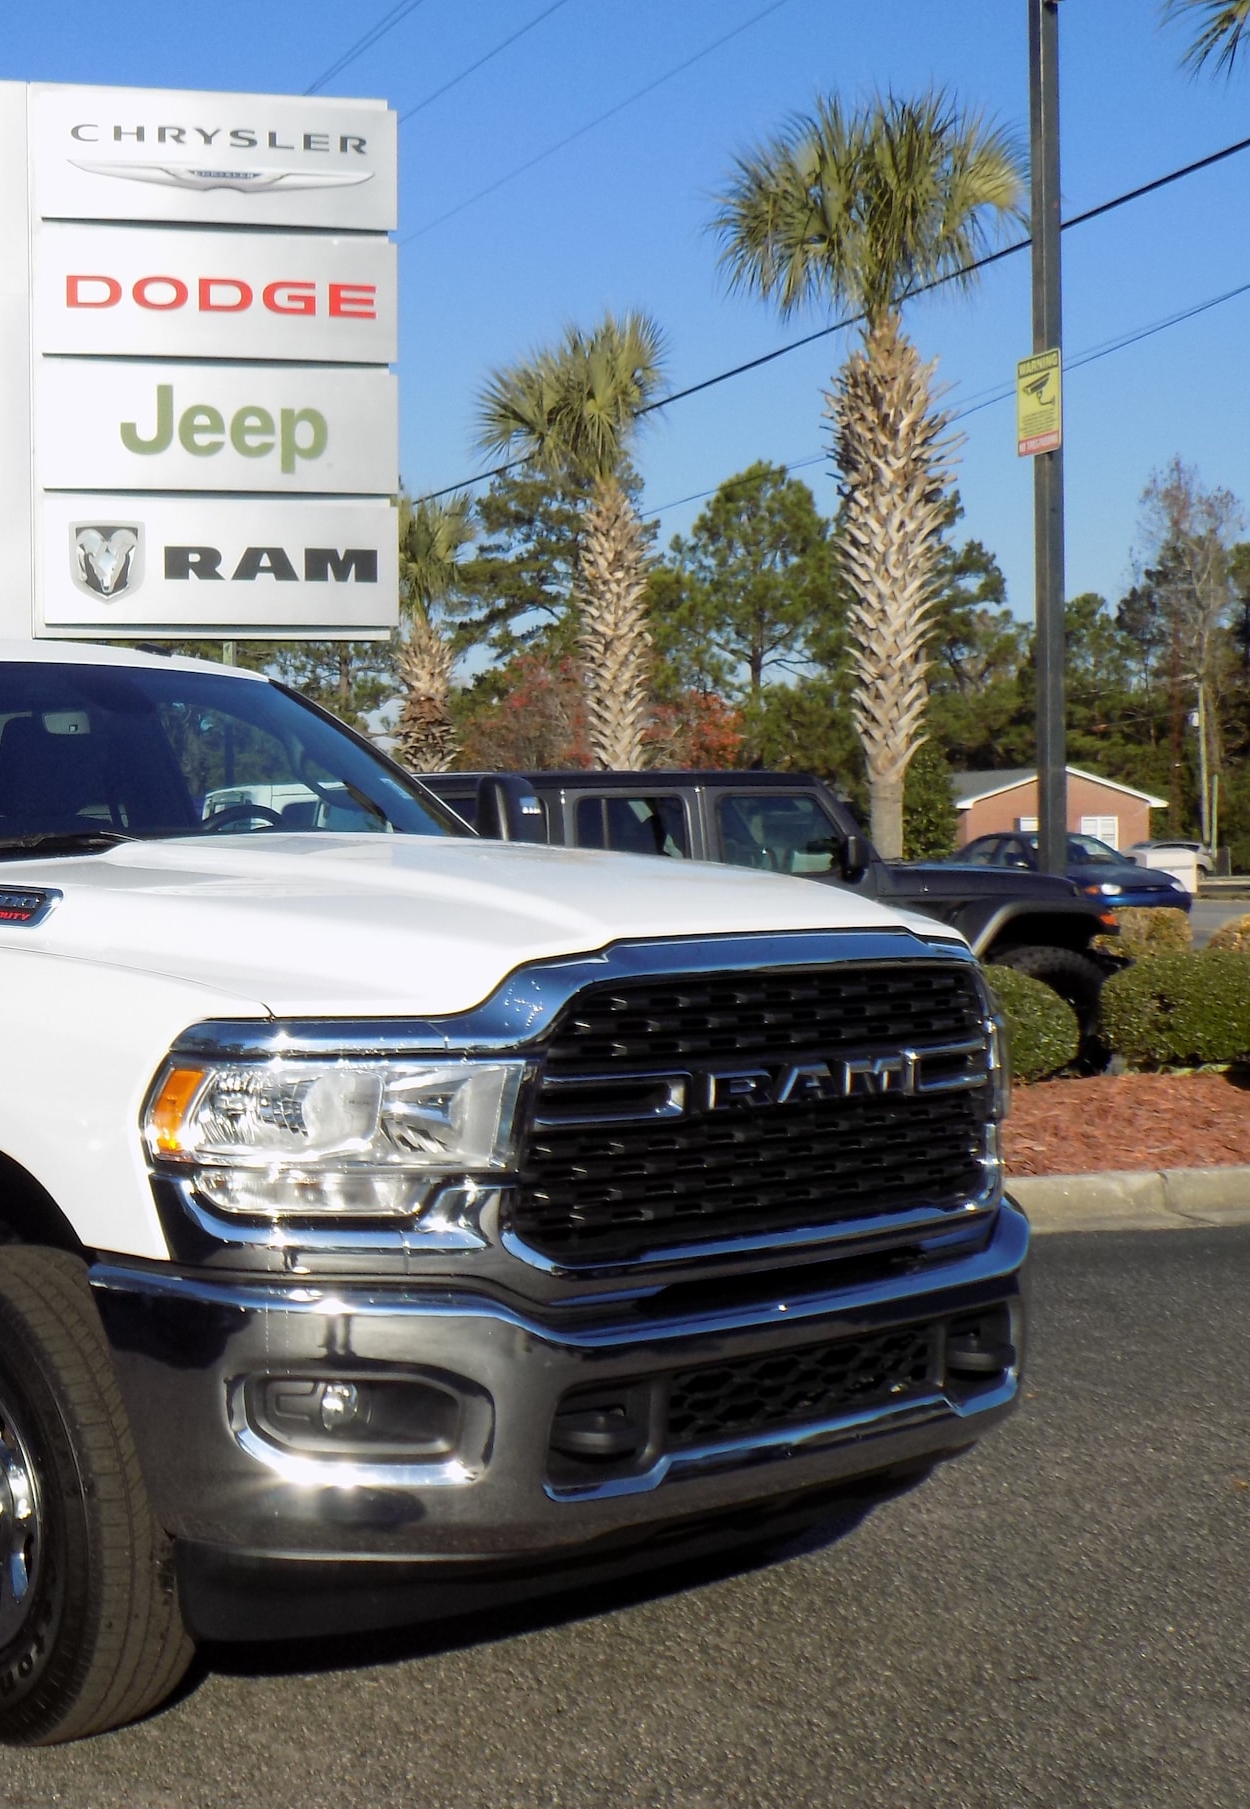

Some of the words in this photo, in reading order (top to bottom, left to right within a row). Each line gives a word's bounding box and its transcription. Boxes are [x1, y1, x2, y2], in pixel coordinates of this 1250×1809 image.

[70, 123, 368, 155] CHRYSLER
[66, 274, 377, 320] DODGE
[120, 384, 329, 474] Jeep
[163, 545, 378, 583] RAM
[709, 1056, 902, 1111] RAM
